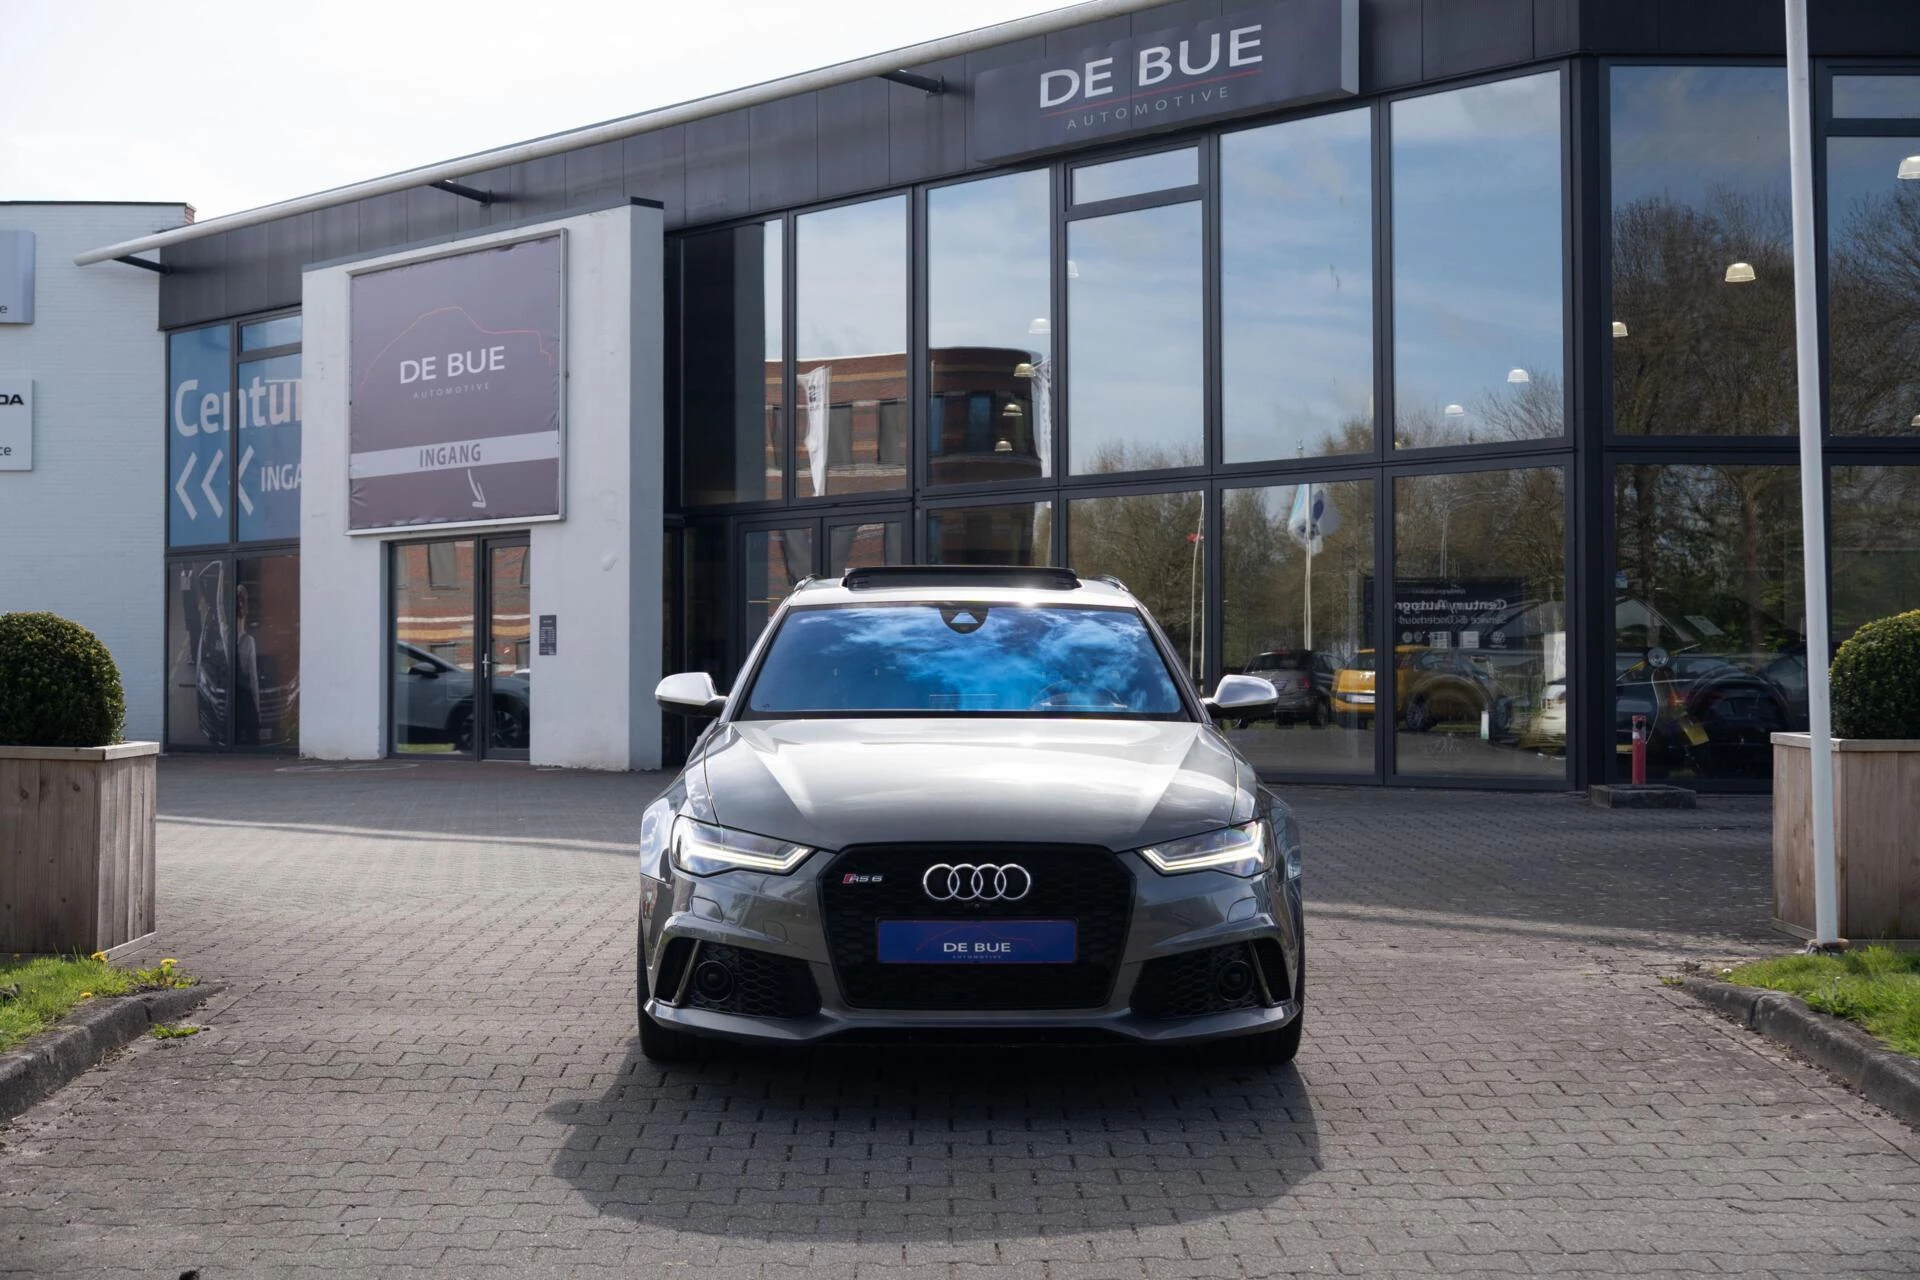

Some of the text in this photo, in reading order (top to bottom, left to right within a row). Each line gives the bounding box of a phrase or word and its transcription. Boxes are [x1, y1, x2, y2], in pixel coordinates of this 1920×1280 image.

[1039, 23, 1263, 109] DE BUE
[1066, 86, 1229, 130] AUTOMOTIVE
[400, 345, 505, 385] DE BUE
[413, 382, 489, 400] AUTOMOTIVE
[419, 443, 481, 468] INGANG
[943, 942, 1011, 952] DE BUE
